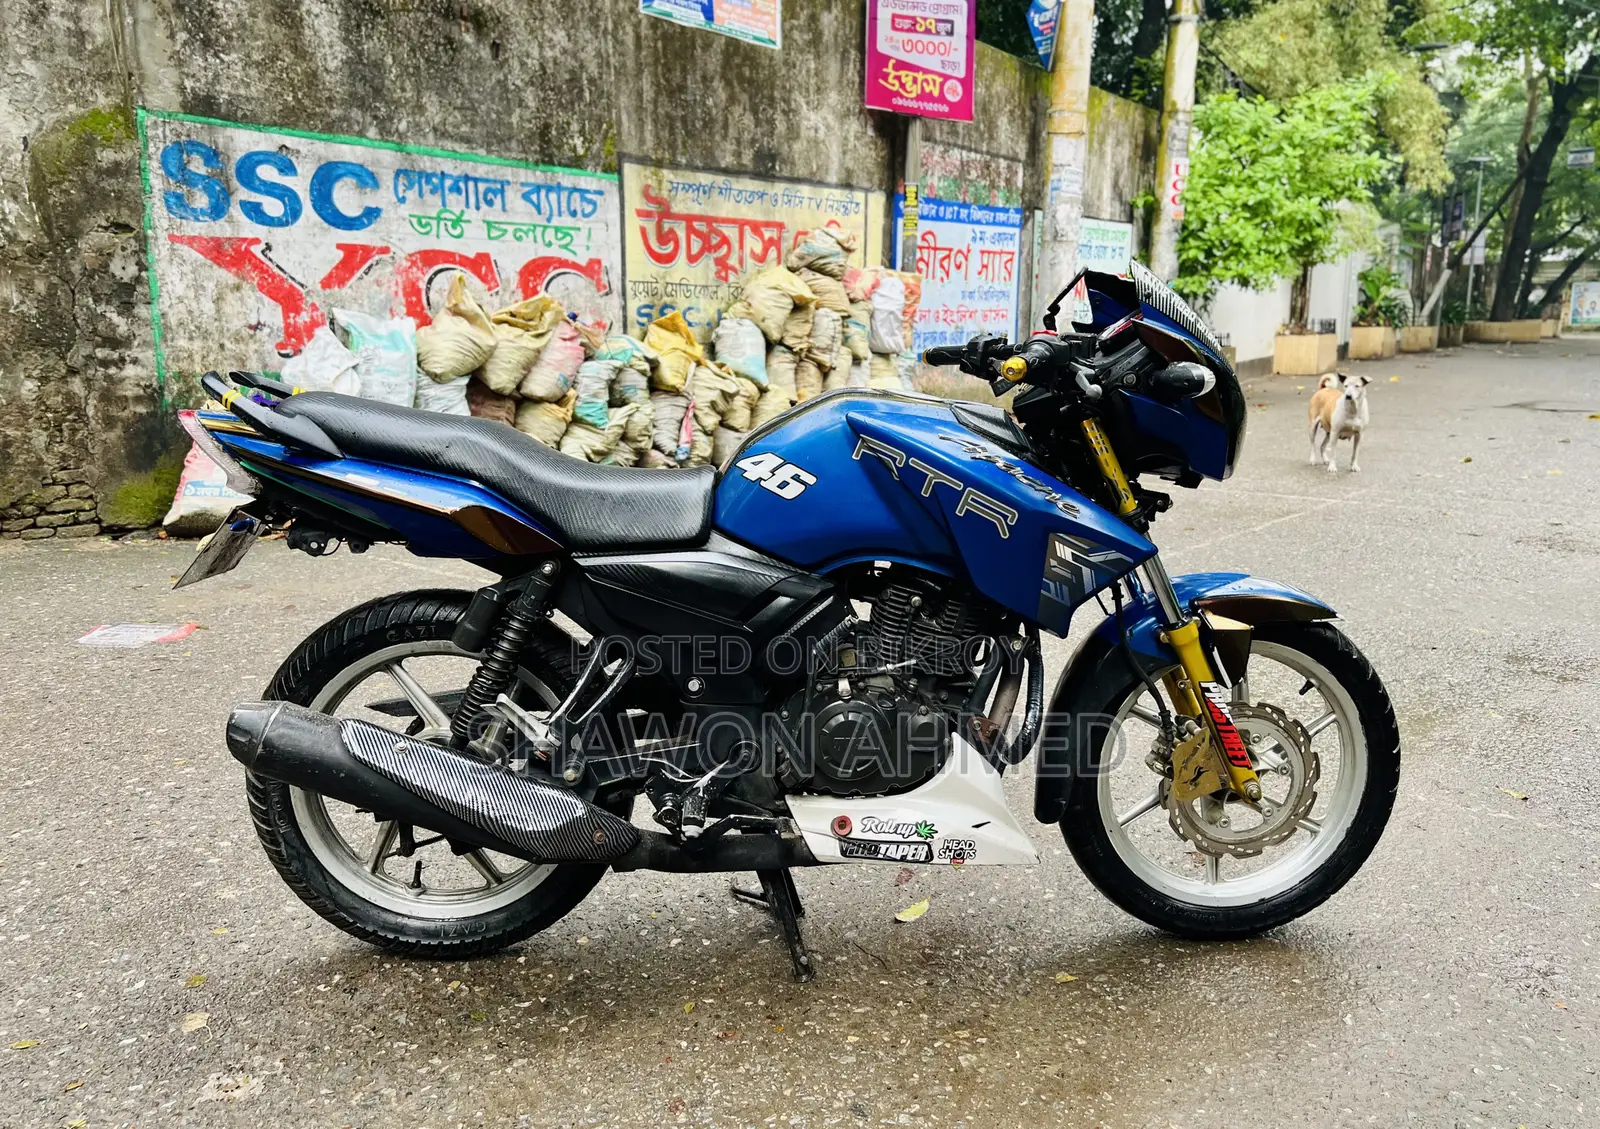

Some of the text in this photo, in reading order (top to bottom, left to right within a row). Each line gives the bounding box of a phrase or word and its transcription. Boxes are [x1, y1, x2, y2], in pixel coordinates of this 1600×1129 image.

[916, 16, 937, 34] ১৭
[160, 139, 384, 232] SSC
[520, 181, 604, 223] ব্যাচে
[667, 180, 716, 205] সম্পূর্ণ
[807, 196, 823, 210] TV
[408, 208, 472, 240] ভর্তি
[977, 249, 1015, 283] স্যার
[735, 452, 818, 501] 46
[852, 434, 1019, 539] RTR
[937, 432, 1081, 519] Apache
[938, 849, 977, 860] SHOTS
[943, 838, 976, 850] HEAD
[440, 921, 487, 937] GAZI
